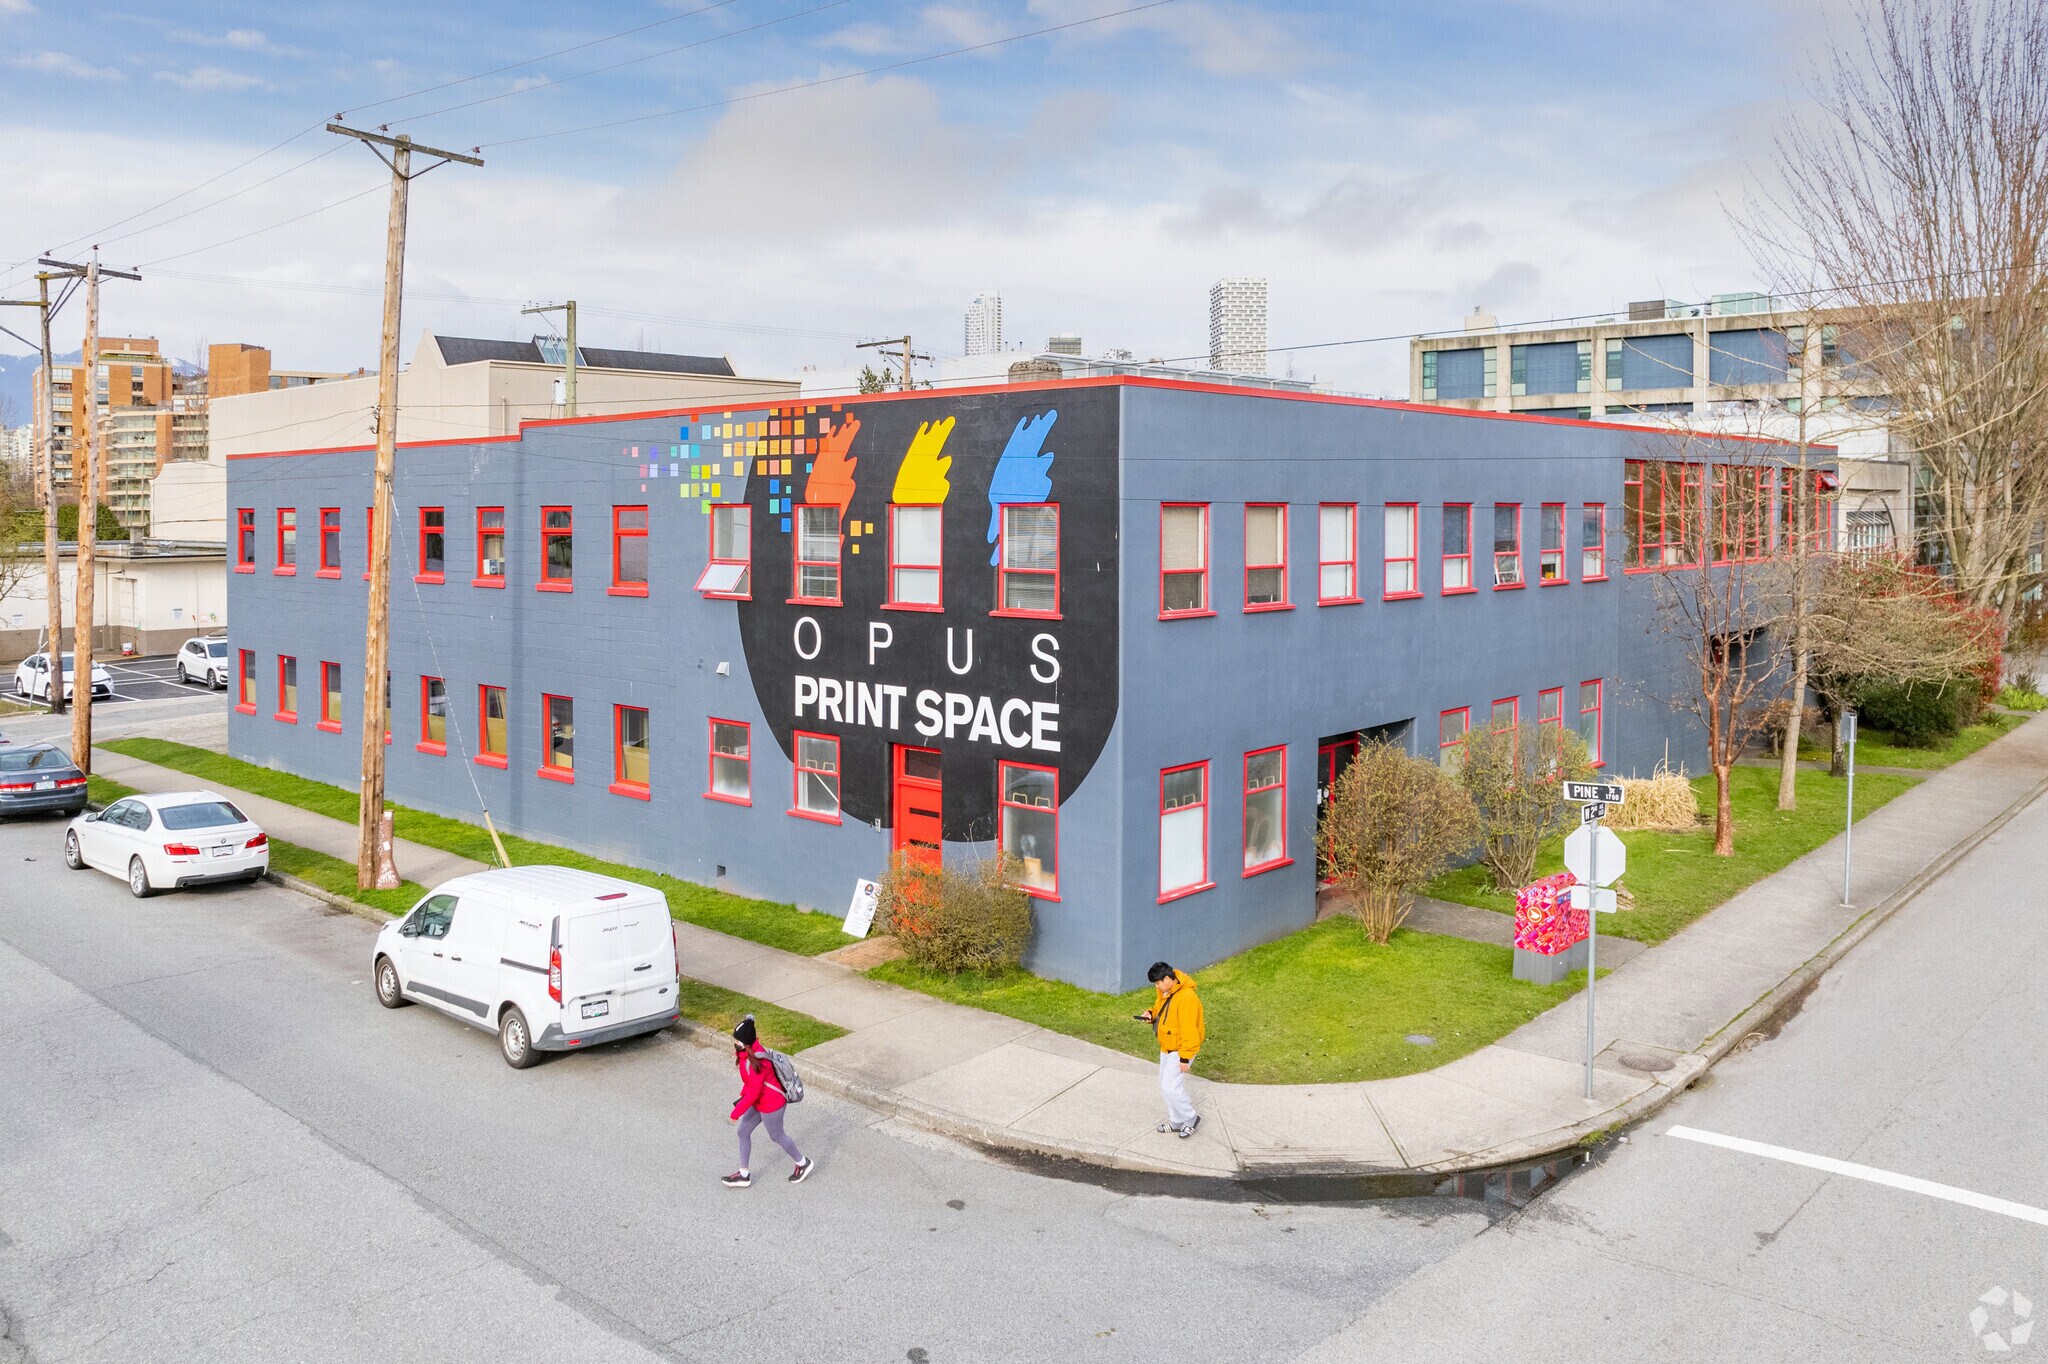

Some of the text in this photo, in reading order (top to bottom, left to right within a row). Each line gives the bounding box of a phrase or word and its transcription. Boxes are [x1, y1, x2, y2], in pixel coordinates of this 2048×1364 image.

[793, 616, 1061, 683] OPUS
[794, 675, 1062, 752] PRINT SPACE
[1574, 785, 1599, 799] PINE
